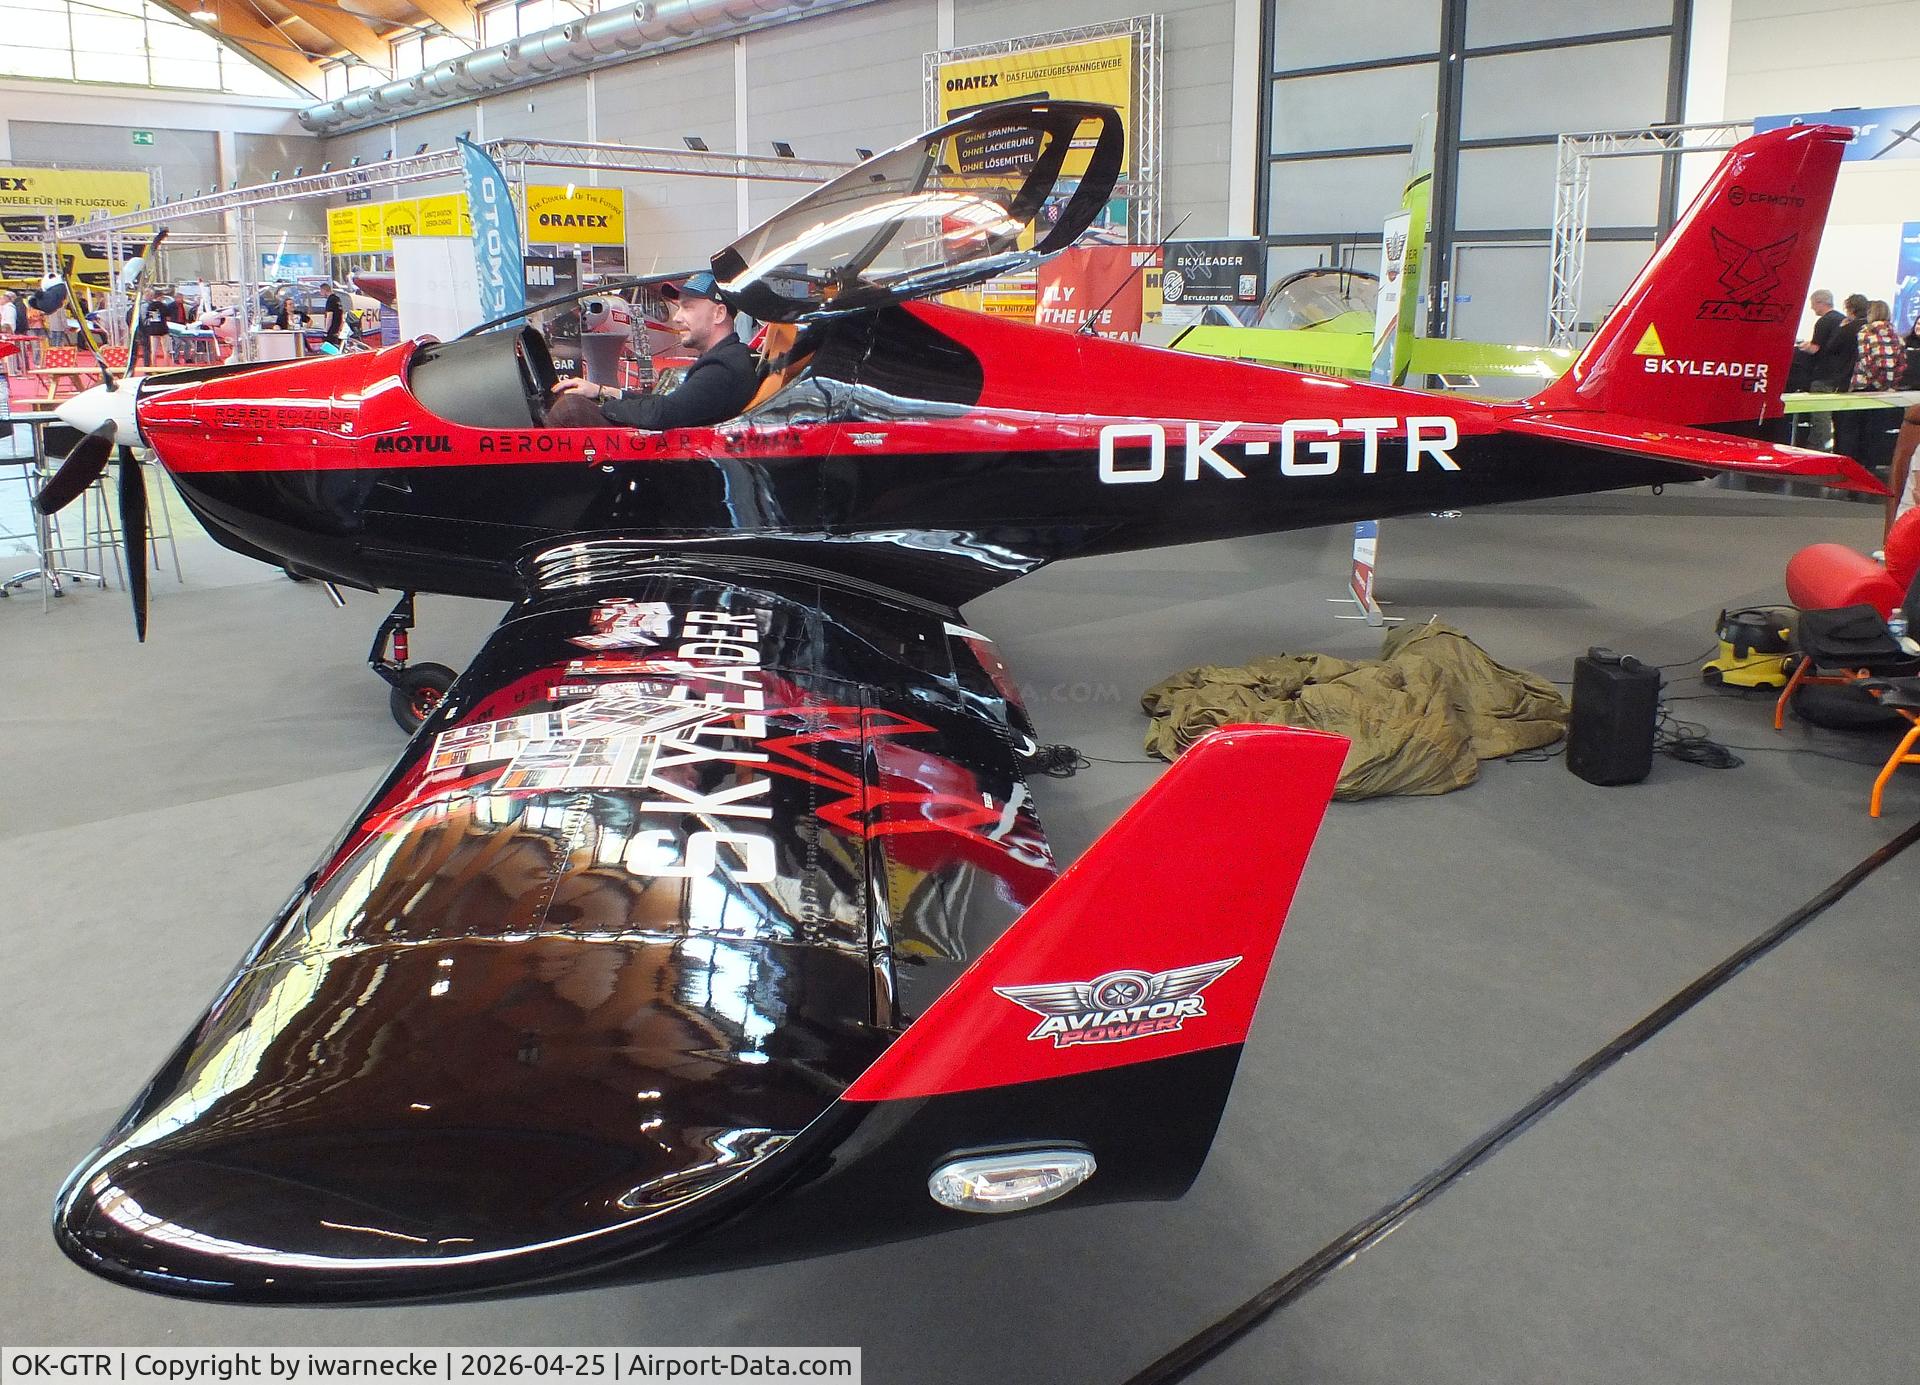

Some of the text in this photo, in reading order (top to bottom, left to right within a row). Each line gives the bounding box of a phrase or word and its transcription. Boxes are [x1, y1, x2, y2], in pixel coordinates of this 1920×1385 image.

[946, 58, 1122, 92] ORATEX DAS FLUGZEUGBESPANNGEWEBE
[962, 136, 1035, 159] OHNE LACKIERUNG
[965, 133, 986, 144] OHNE
[961, 153, 1034, 173] OHNE LÖSEMITTEL
[34, 195, 53, 206] FÜR
[56, 198, 73, 206] IHR
[539, 213, 608, 228] ORATEX
[1177, 256, 1244, 267] SKYLEADER
[1044, 308, 1075, 324] THE
[1645, 359, 1769, 377] SKYLEADER
[374, 435, 453, 453] MOTUL
[479, 434, 691, 453] AEROHANGAR
[1099, 416, 1461, 484] OK-GTR
[626, 607, 777, 884] SKYLEADER
[1033, 996, 1206, 1039] AVIATOR
[1057, 1017, 1180, 1046] POWER
